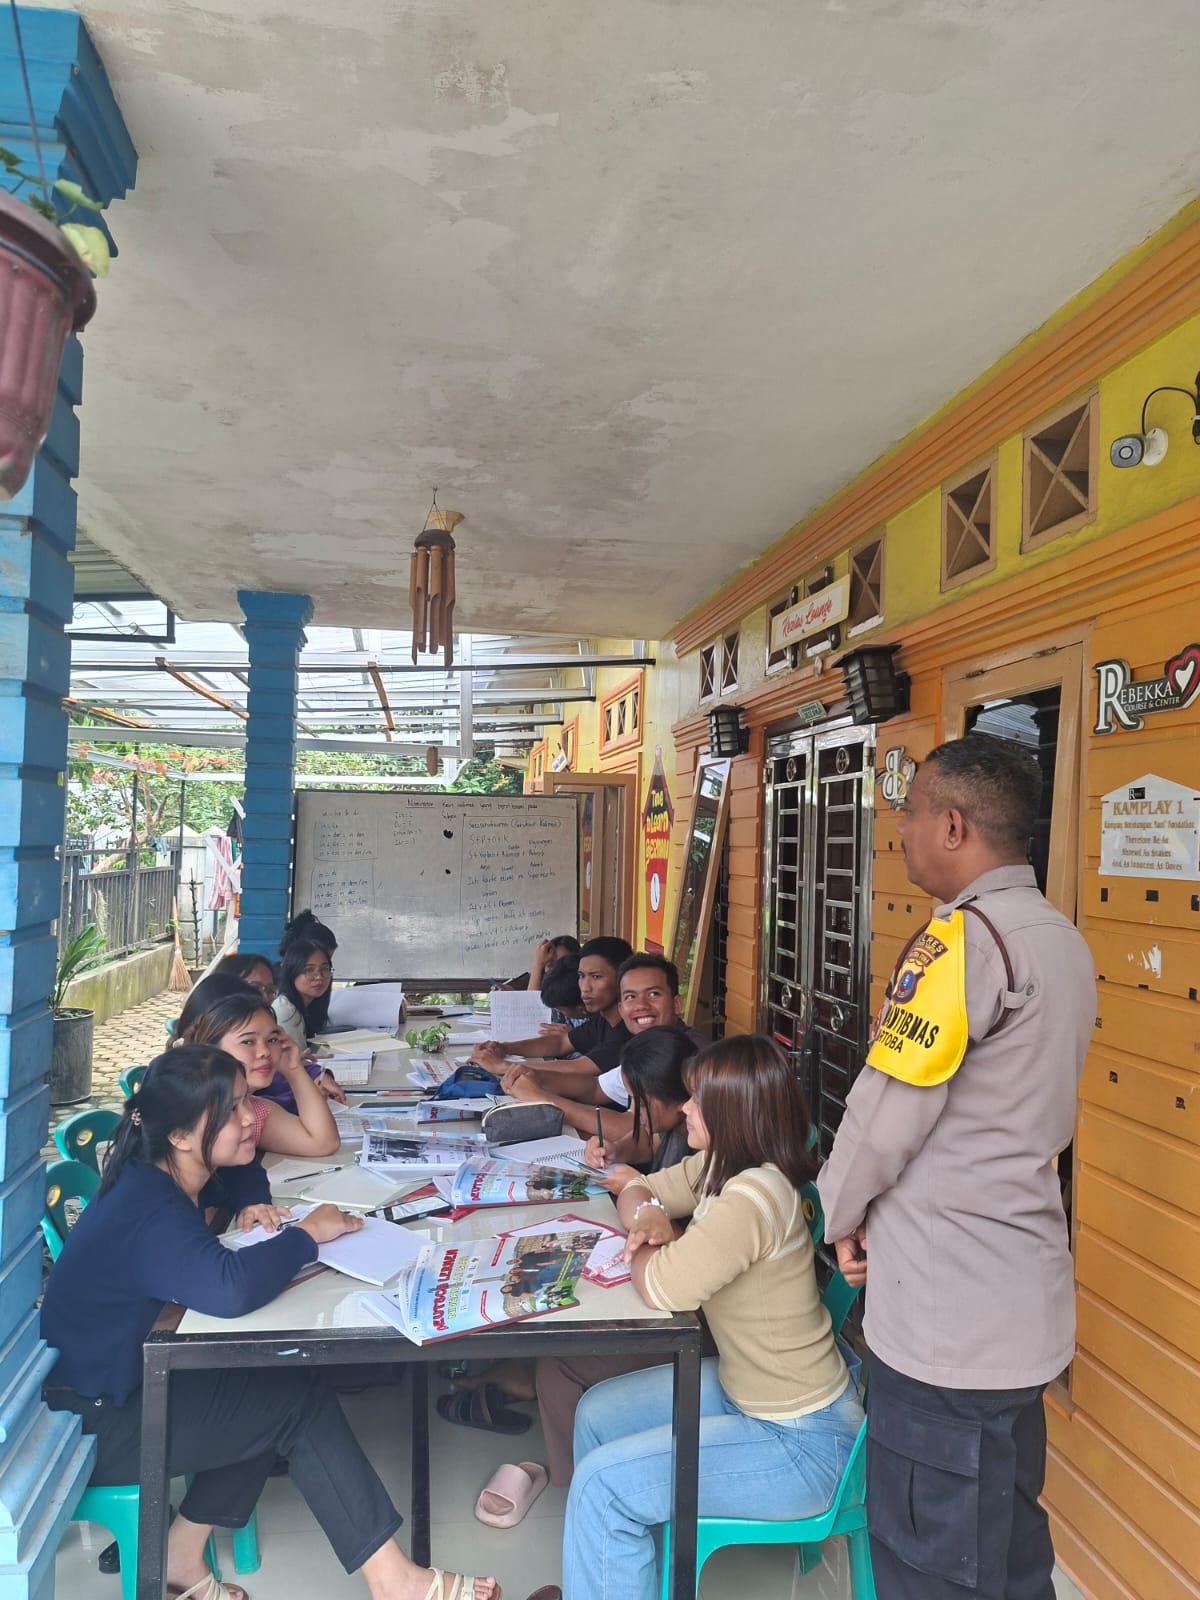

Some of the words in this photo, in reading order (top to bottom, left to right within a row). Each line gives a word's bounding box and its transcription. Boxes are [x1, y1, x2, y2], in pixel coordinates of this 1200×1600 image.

[1096, 664, 1173, 730] REBEKKA
[1124, 702, 1147, 712] COURSE
[1155, 697, 1180, 706] CENTER
[1113, 800, 1172, 815] KAMPLAY
[1177, 800, 1184, 814] 1
